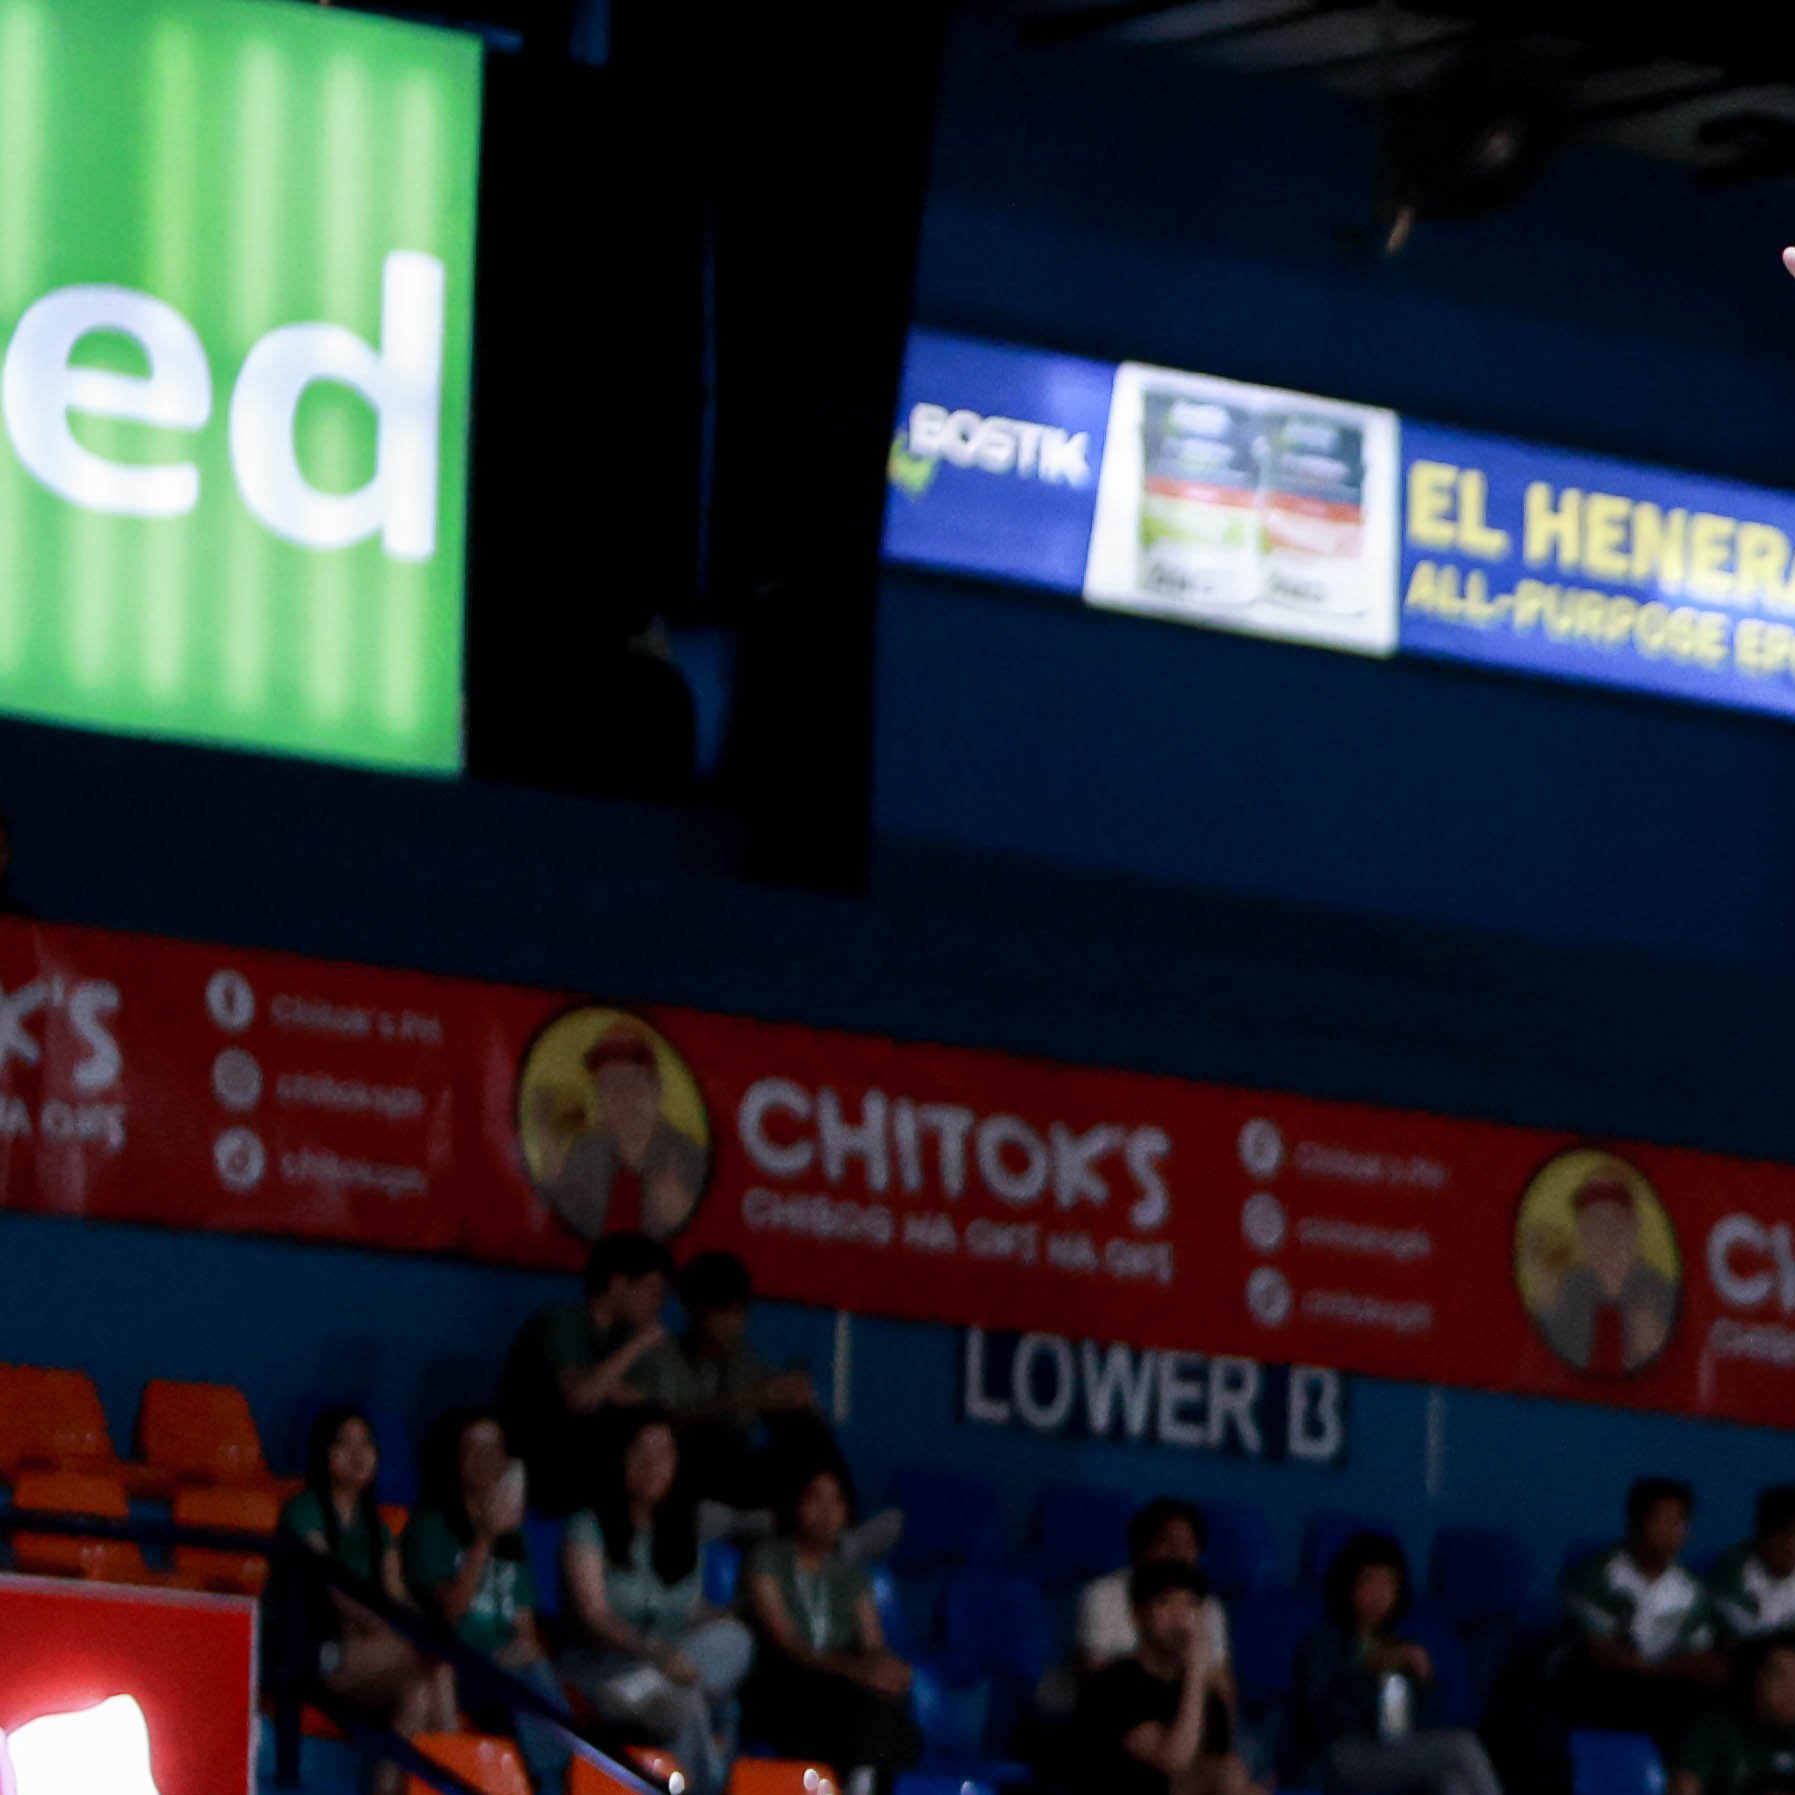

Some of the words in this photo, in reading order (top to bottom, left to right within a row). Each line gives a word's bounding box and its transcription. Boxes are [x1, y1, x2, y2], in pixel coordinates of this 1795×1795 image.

[2, 250, 445, 563] ed
[1407, 459, 1509, 559] EL
[964, 1326, 1261, 1455] LOWER
[1287, 1367, 1343, 1461] B
